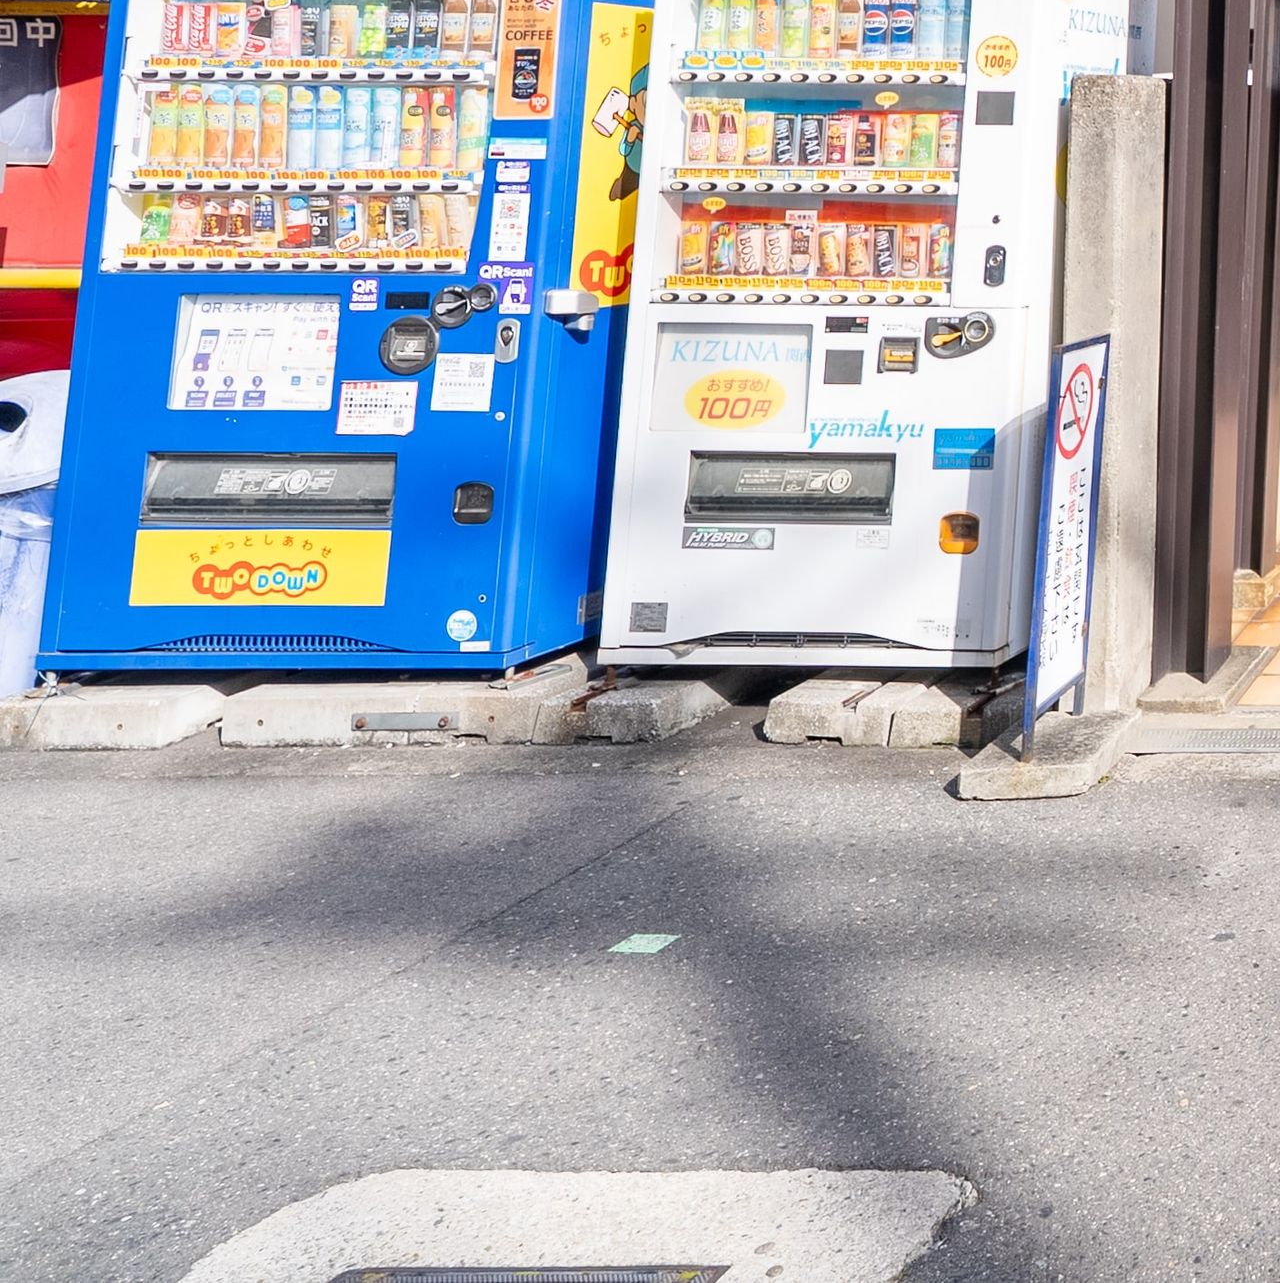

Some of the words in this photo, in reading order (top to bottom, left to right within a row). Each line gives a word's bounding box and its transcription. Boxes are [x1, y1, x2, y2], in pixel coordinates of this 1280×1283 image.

[1068, 9, 1127, 38] KIZUNA
[505, 30, 553, 41] COFFEE
[151, 58, 170, 66] 100
[177, 58, 196, 66] 100
[290, 59, 310, 67] 100
[984, 55, 1012, 69] 100円
[531, 96, 547, 106] 100
[774, 119, 793, 163] BLACK
[802, 119, 822, 163] BLACK
[139, 169, 158, 177] 100
[193, 170, 213, 178] 100
[277, 171, 297, 179] 100
[305, 171, 324, 179] 100
[338, 171, 358, 179] 100
[365, 170, 384, 178] 100
[391, 170, 411, 178] 100
[417, 170, 437, 178] 100
[128, 247, 147, 255] 100
[158, 248, 177, 256] 100
[184, 248, 204, 256] 100
[212, 249, 232, 257] 100
[381, 250, 400, 258] 100
[439, 249, 458, 257] 100
[740, 236, 757, 271] BOSS
[768, 236, 785, 271] BOSS
[875, 231, 894, 275] BLACK
[479, 265, 504, 279] QR
[503, 266, 533, 278] Scan!
[590, 258, 633, 288] TW
[351, 279, 378, 294] QR
[351, 293, 377, 302] Scan!
[283, 302, 340, 313] すぐに使え
[671, 340, 780, 362] KIZUNA
[707, 379, 770, 392] おすすめ!
[698, 398, 773, 419] 100円
[808, 409, 925, 448] yamakyu
[687, 532, 749, 546] HYBRID
[190, 534, 333, 563] ちょっとしあわせ
[201, 569, 249, 594] TWO
[257, 568, 319, 591] DOWN
